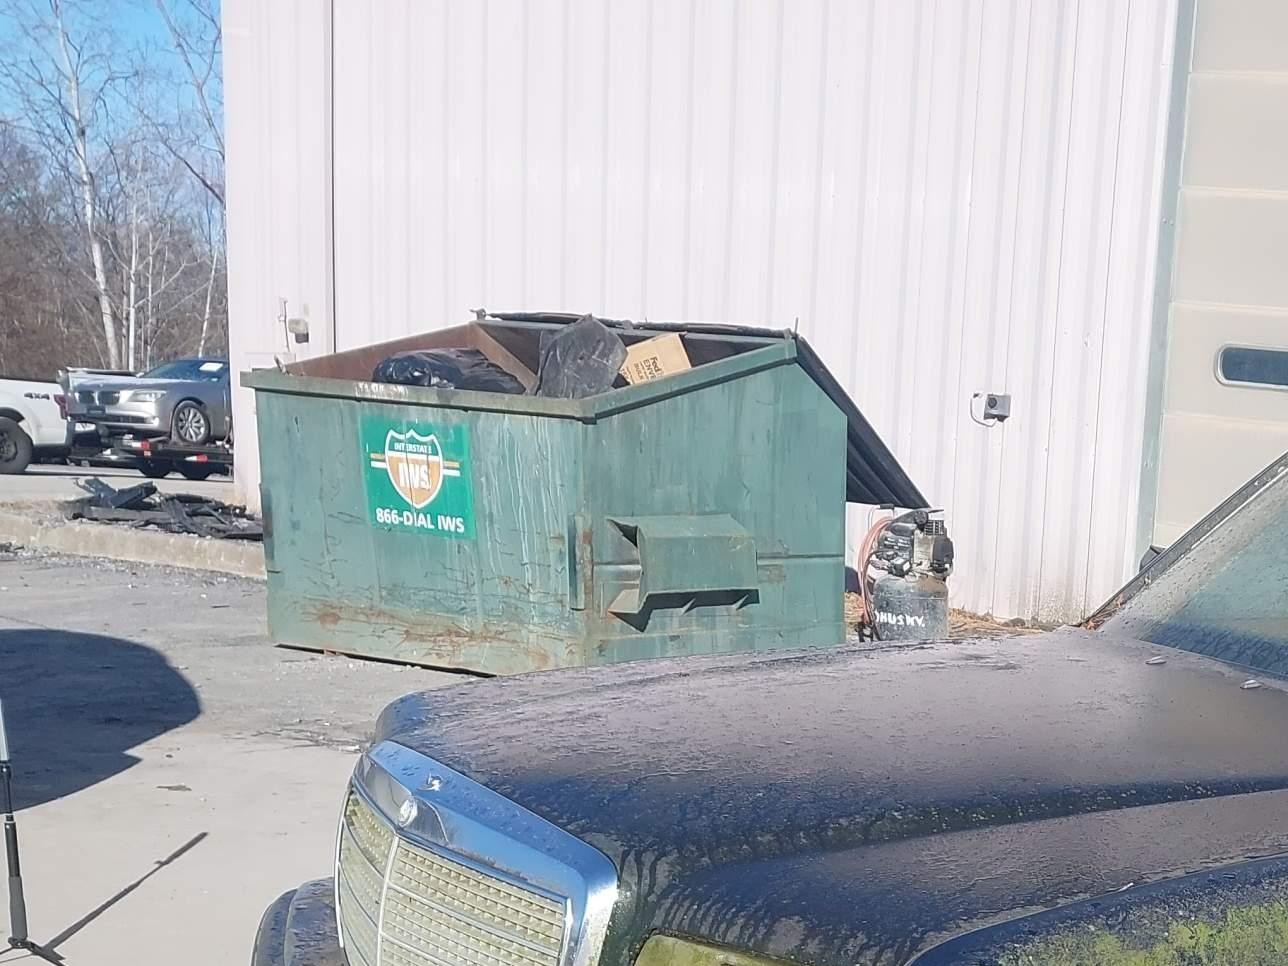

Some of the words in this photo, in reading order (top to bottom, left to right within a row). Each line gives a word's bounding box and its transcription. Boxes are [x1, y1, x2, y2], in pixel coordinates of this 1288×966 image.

[398, 462, 432, 490] IWS
[375, 507, 435, 529] 866-DIAL
[437, 514, 465, 533] IWS
